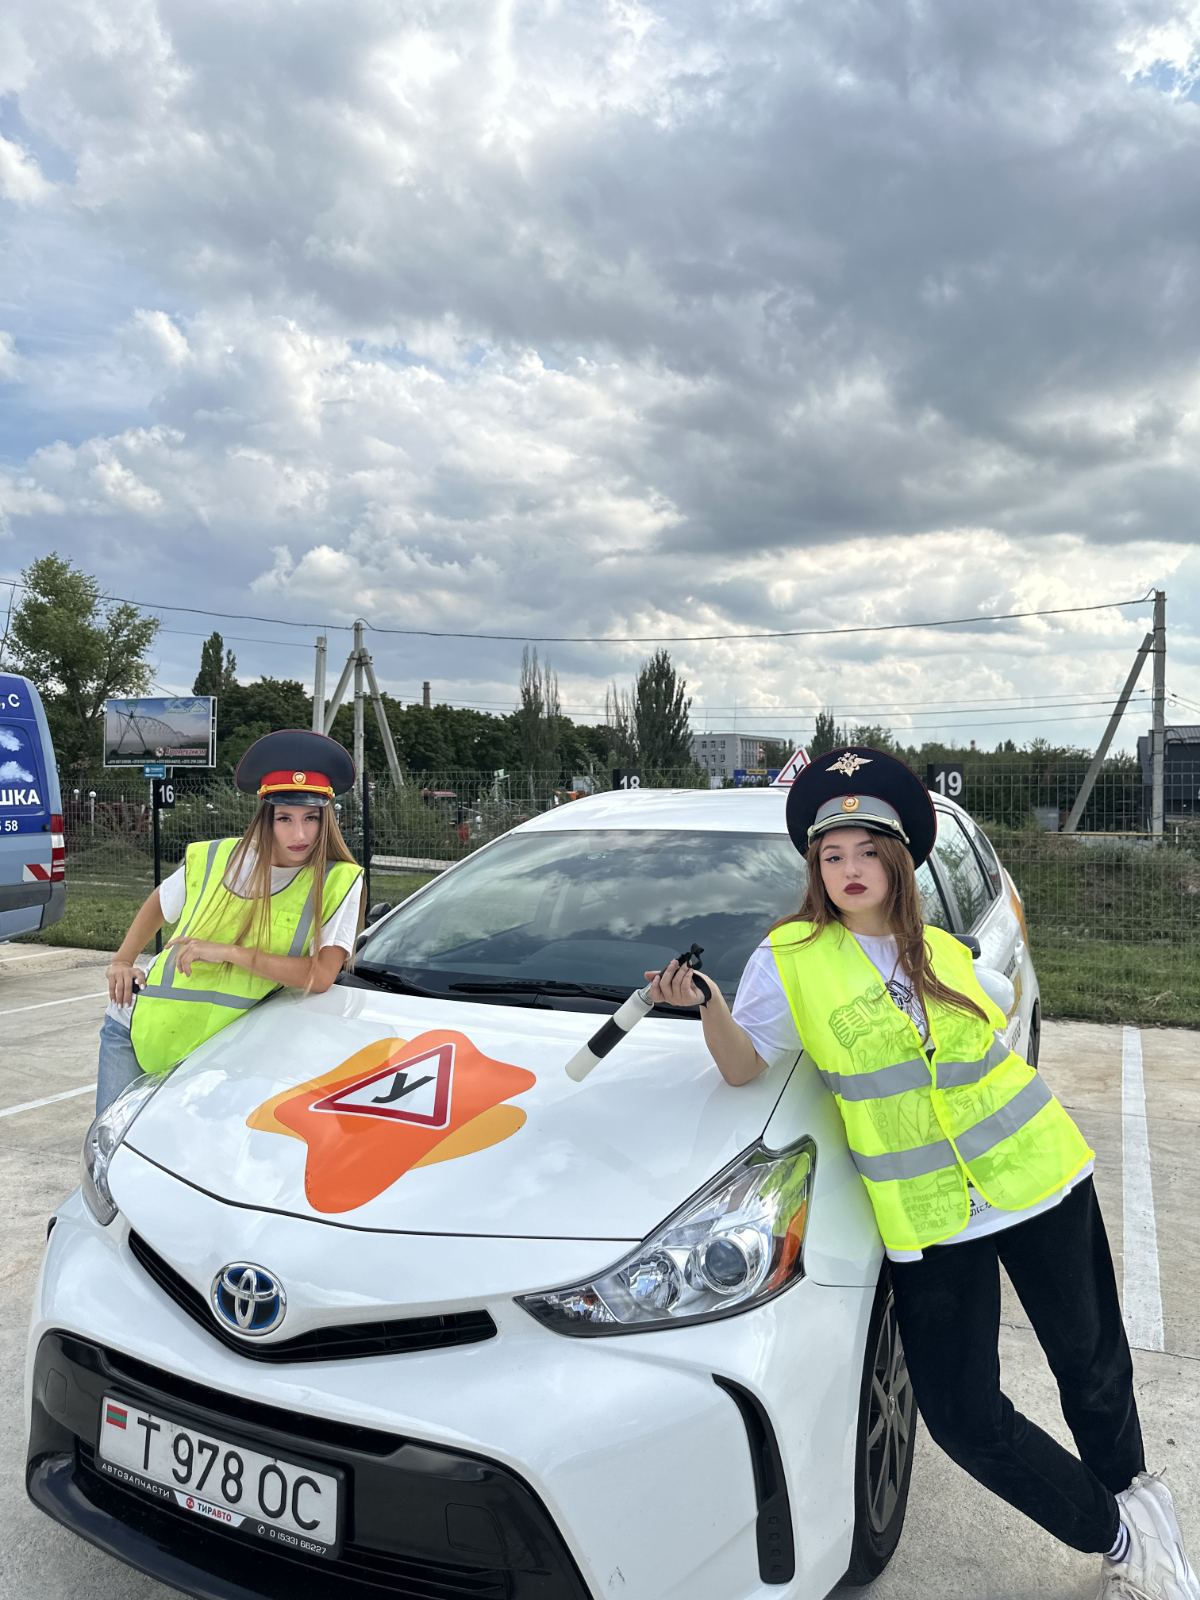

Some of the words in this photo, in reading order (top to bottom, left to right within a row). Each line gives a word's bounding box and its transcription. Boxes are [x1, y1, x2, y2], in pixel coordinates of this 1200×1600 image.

[159, 784, 175, 803] 16
[619, 775, 641, 790] 18
[935, 771, 963, 797] 19
[5, 819, 19, 832] 58
[370, 1072, 437, 1104] У
[101, 1462, 170, 1499] АВТОЗАПЧАСТИ
[172, 1432, 245, 1504] 978
[197, 1502, 232, 1522] ТИРАВТО
[269, 1529, 276, 1538] 0
[277, 1532, 299, 1546] (533)
[300, 1540, 327, 1555] 66227
